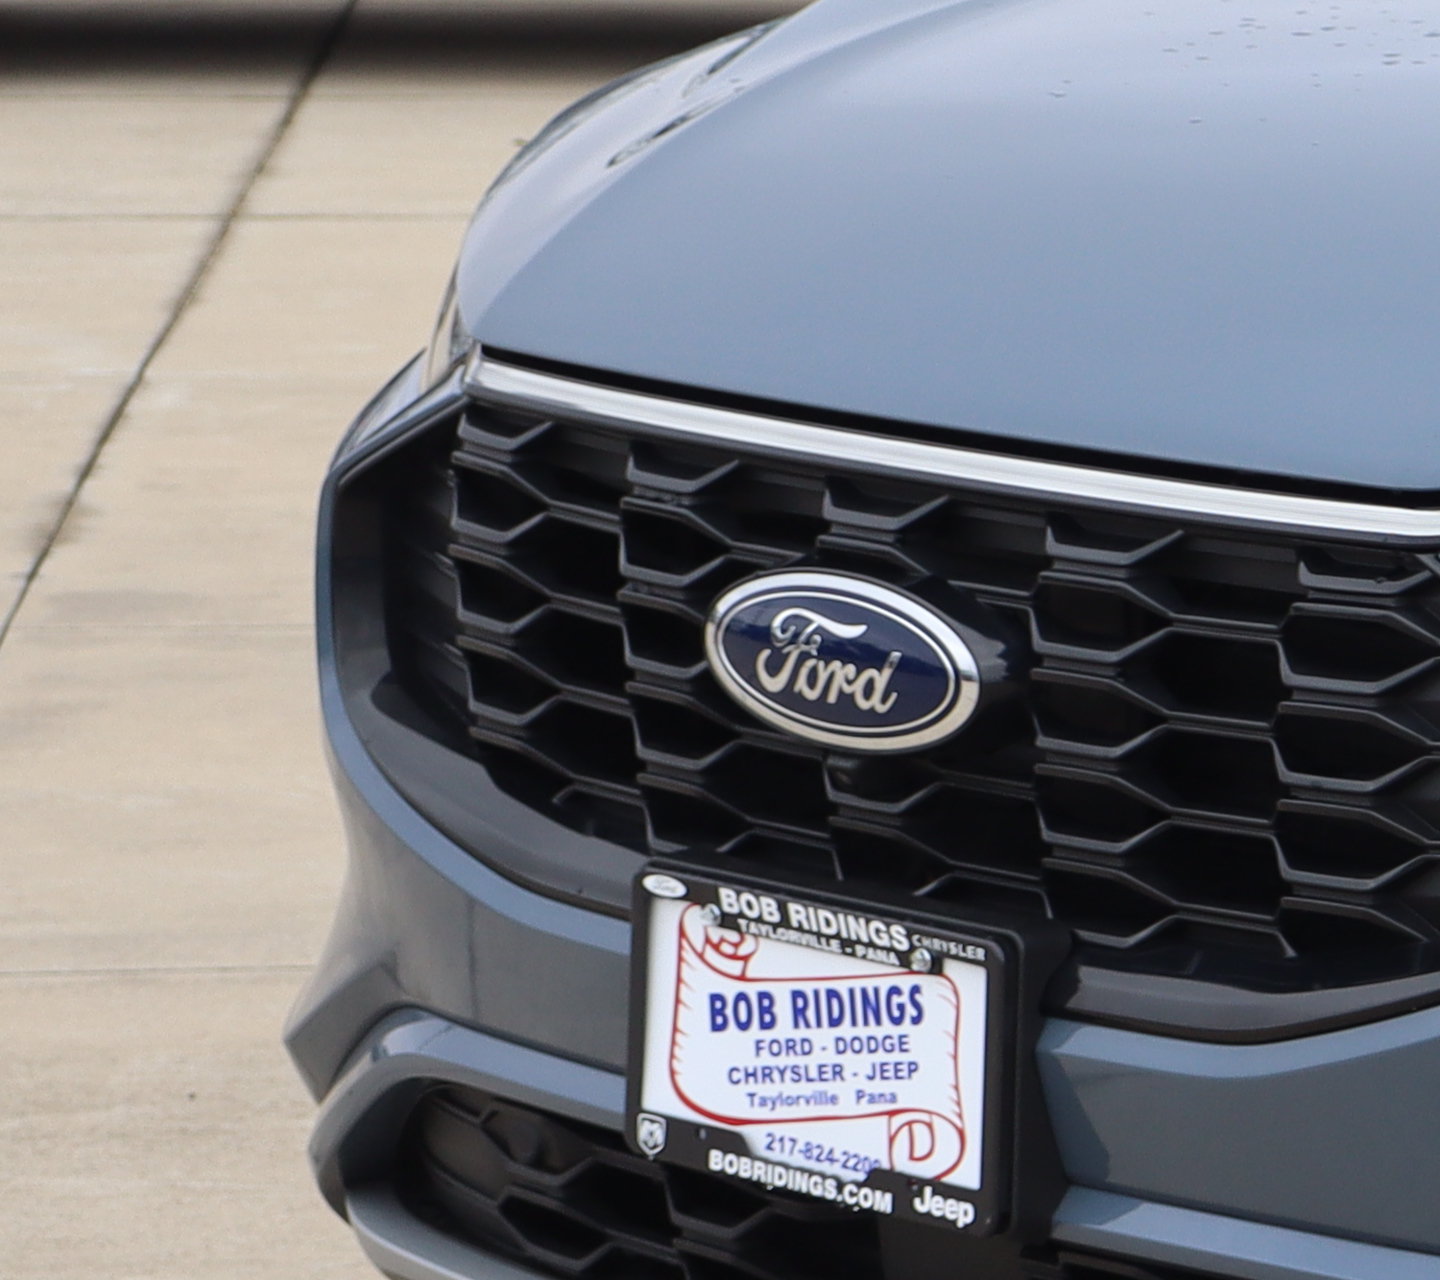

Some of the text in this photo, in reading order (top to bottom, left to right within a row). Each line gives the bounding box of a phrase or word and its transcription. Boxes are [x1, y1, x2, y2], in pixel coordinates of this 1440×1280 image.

[755, 606, 903, 714] Ford
[717, 886, 911, 953] BOB RIDINGS
[737, 917, 843, 954] TAYLORVILLE
[856, 946, 901, 967] PANA
[911, 933, 987, 962] CHRYSLER
[708, 984, 925, 1033] BOB RIDINGS
[755, 1037, 813, 1058] FORD
[834, 1035, 910, 1056] DODGE
[728, 1063, 845, 1085] CHRYSLER
[866, 1061, 919, 1081] JEEP
[746, 1089, 898, 1111] Taylorville Pana
[709, 1148, 893, 1214] BOBRIDINGS.COM
[913, 1185, 976, 1229] Jeep
